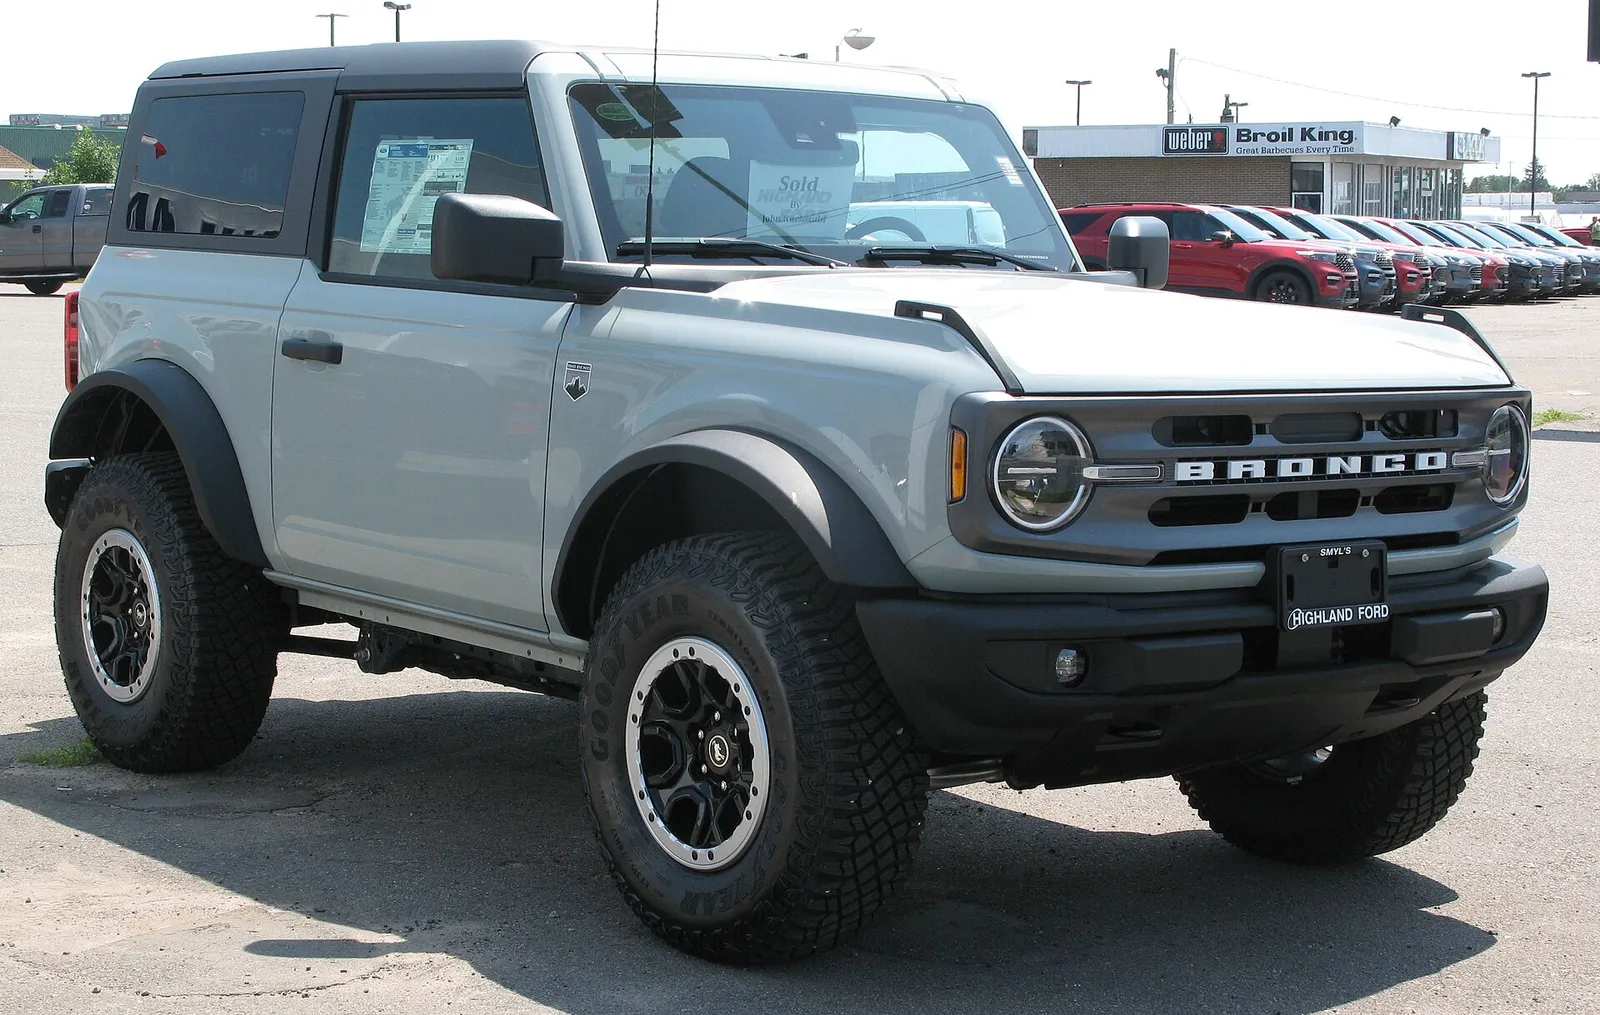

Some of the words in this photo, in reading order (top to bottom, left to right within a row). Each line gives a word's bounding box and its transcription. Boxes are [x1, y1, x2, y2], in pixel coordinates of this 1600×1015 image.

[1168, 131, 1212, 150] weber
[1236, 126, 1294, 143] Broil
[1261, 146, 1304, 154] Barbecues
[1306, 145, 1331, 155] Every
[1332, 145, 1355, 153] Time
[779, 175, 819, 192] Sold
[790, 200, 802, 209] By
[1174, 451, 1449, 481] BRONCO
[1320, 546, 1351, 556] SMYL'S
[1287, 607, 1353, 630] HIGHLAND
[1358, 604, 1389, 621] FORD
